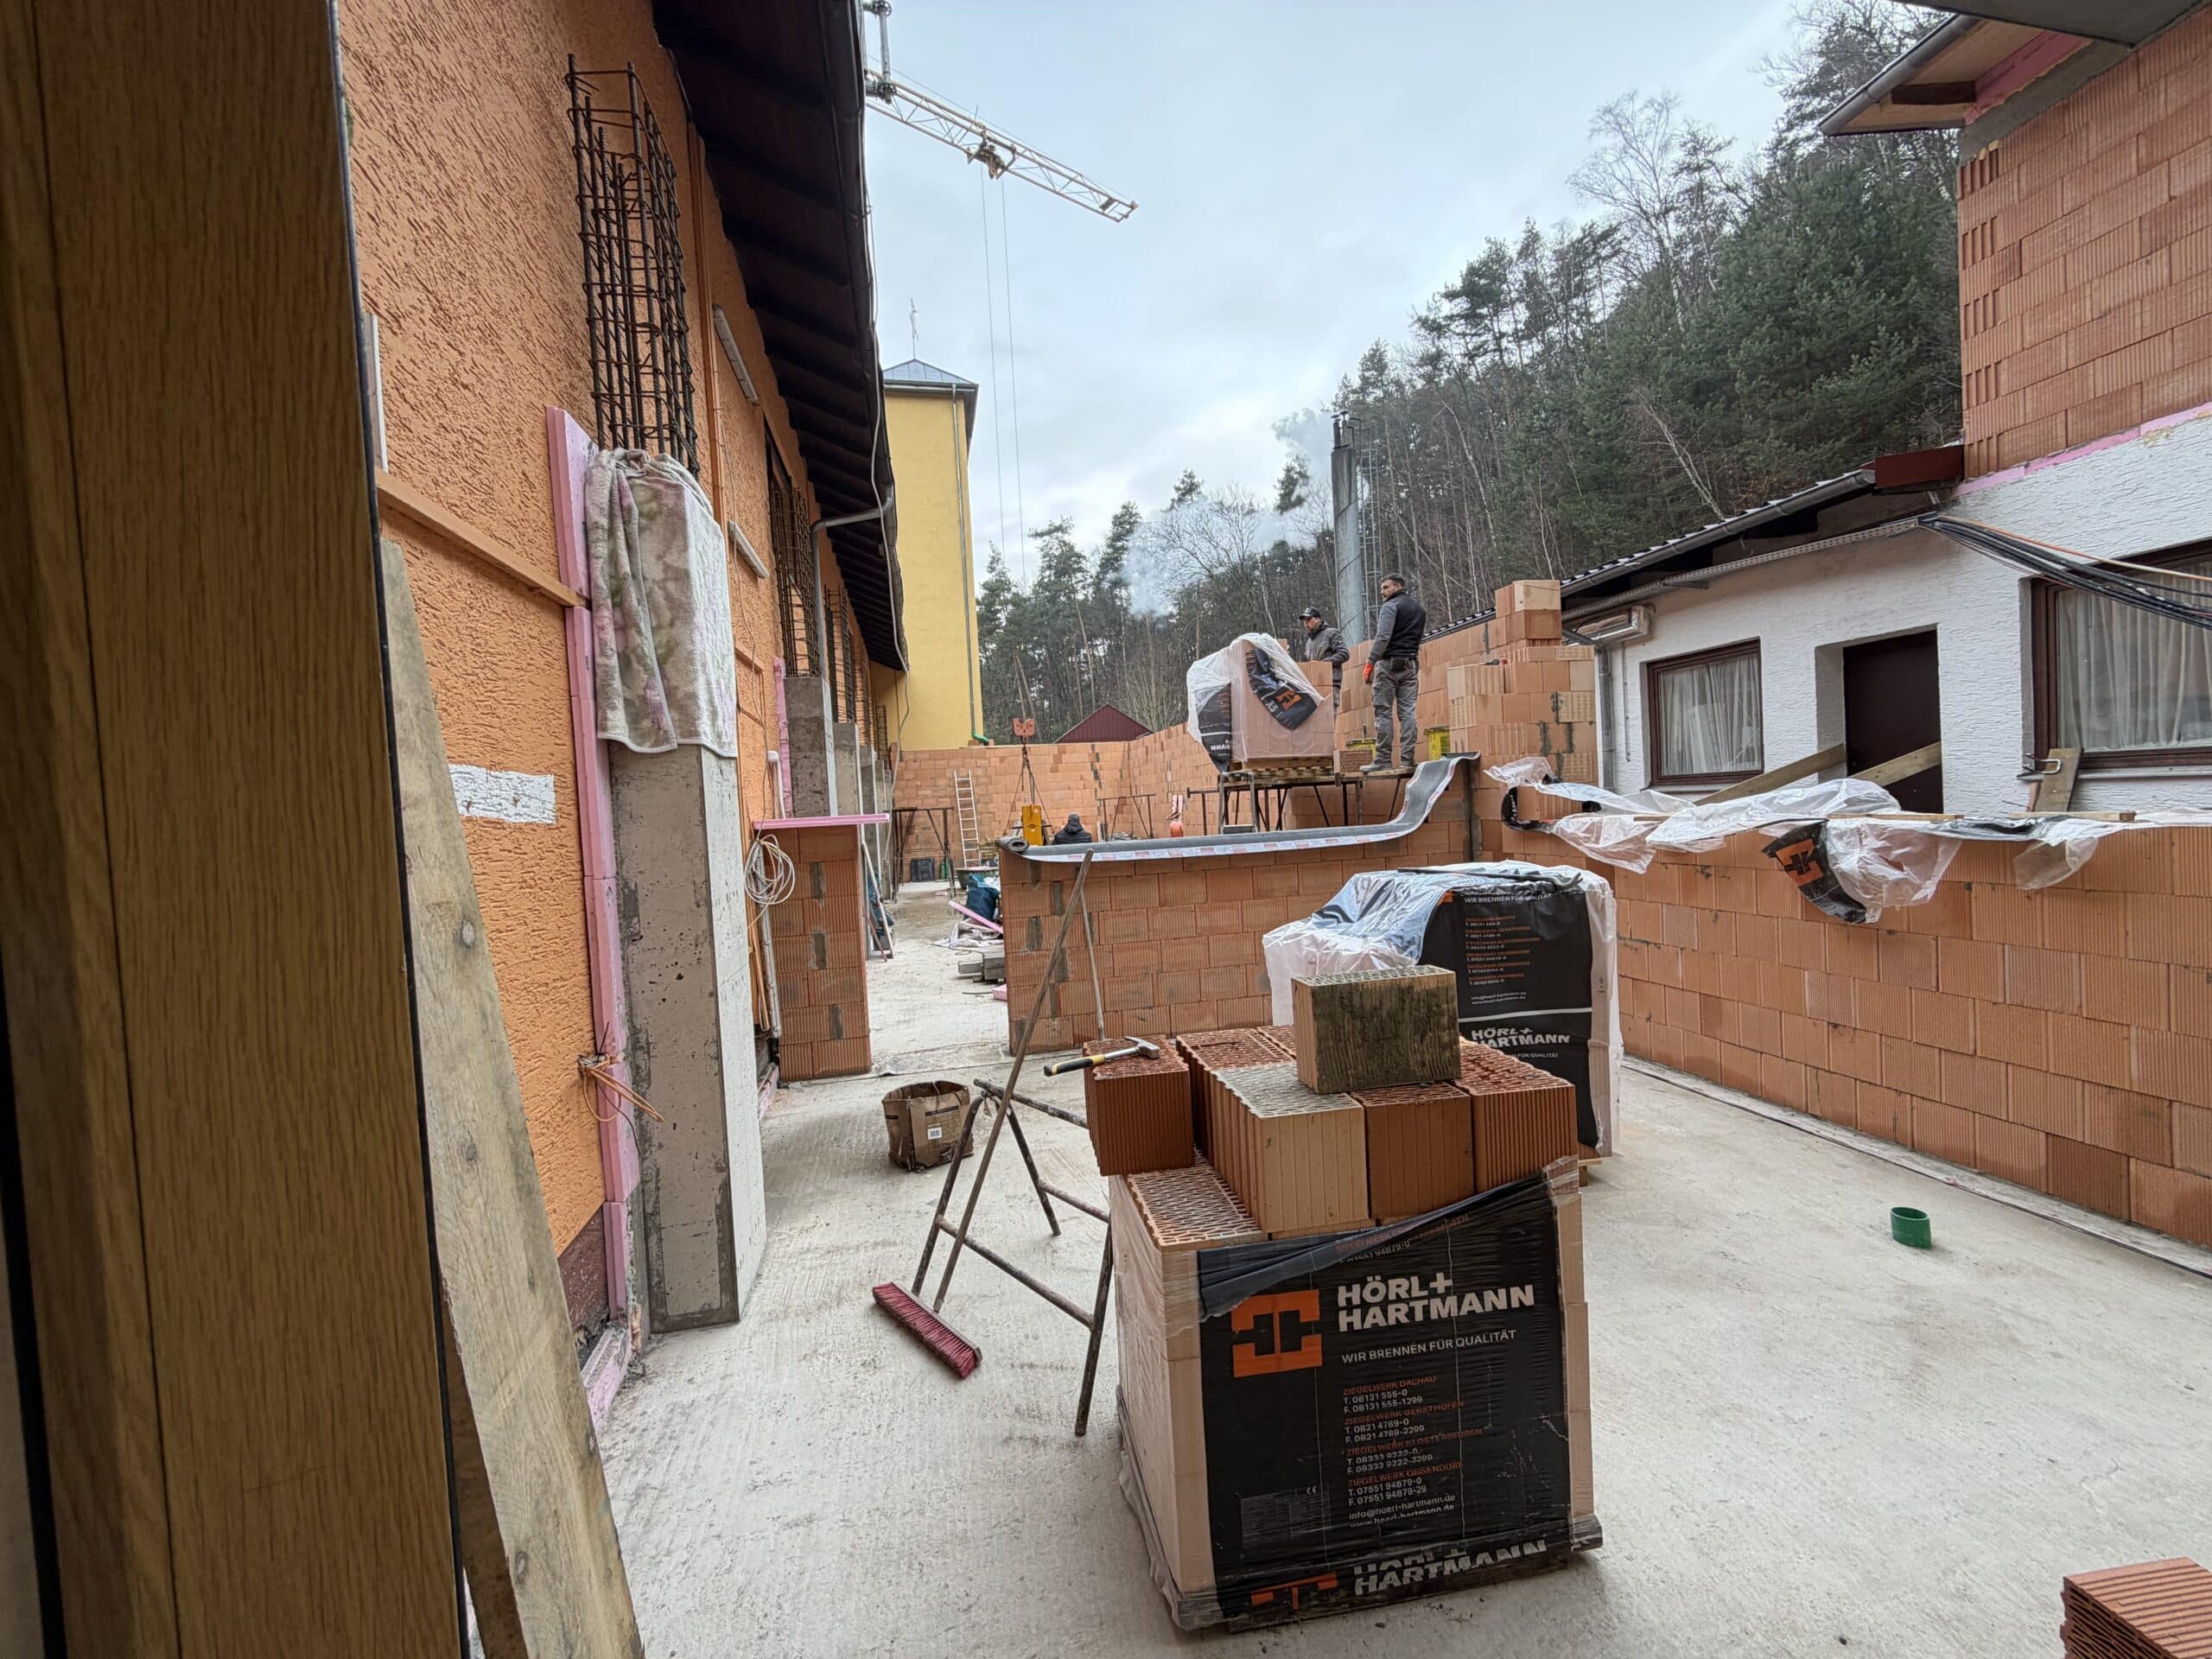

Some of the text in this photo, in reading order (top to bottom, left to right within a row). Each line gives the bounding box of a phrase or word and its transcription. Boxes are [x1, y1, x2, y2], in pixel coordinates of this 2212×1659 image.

[1338, 1272, 1453, 1307] HÖRL+
[1338, 1285, 1535, 1332] HARTMANN
[1341, 1329, 1516, 1363] WIR BRENNEN FÜR QUALITÄT
[1344, 1376, 1437, 1395] ZIEGELWERK DACHAU
[1344, 1395, 1423, 1414] F. 08131 555-1299
[1352, 1392, 1379, 1404] 08131
[1382, 1389, 1408, 1400] 555-0
[1344, 1410, 1402, 1425] ZIEGELWERK
[1353, 1422, 1376, 1433] 0821
[1377, 1418, 1409, 1430] 4789-0
[1354, 1432, 1376, 1443] 0821
[1377, 1425, 1425, 1438] 4789-2299
[1348, 1471, 1404, 1487] ZIEGELWERK
[1348, 1477, 1422, 1497] T. 07551 94879-0
[1348, 1485, 1427, 1506] F. 07551 94879-29
